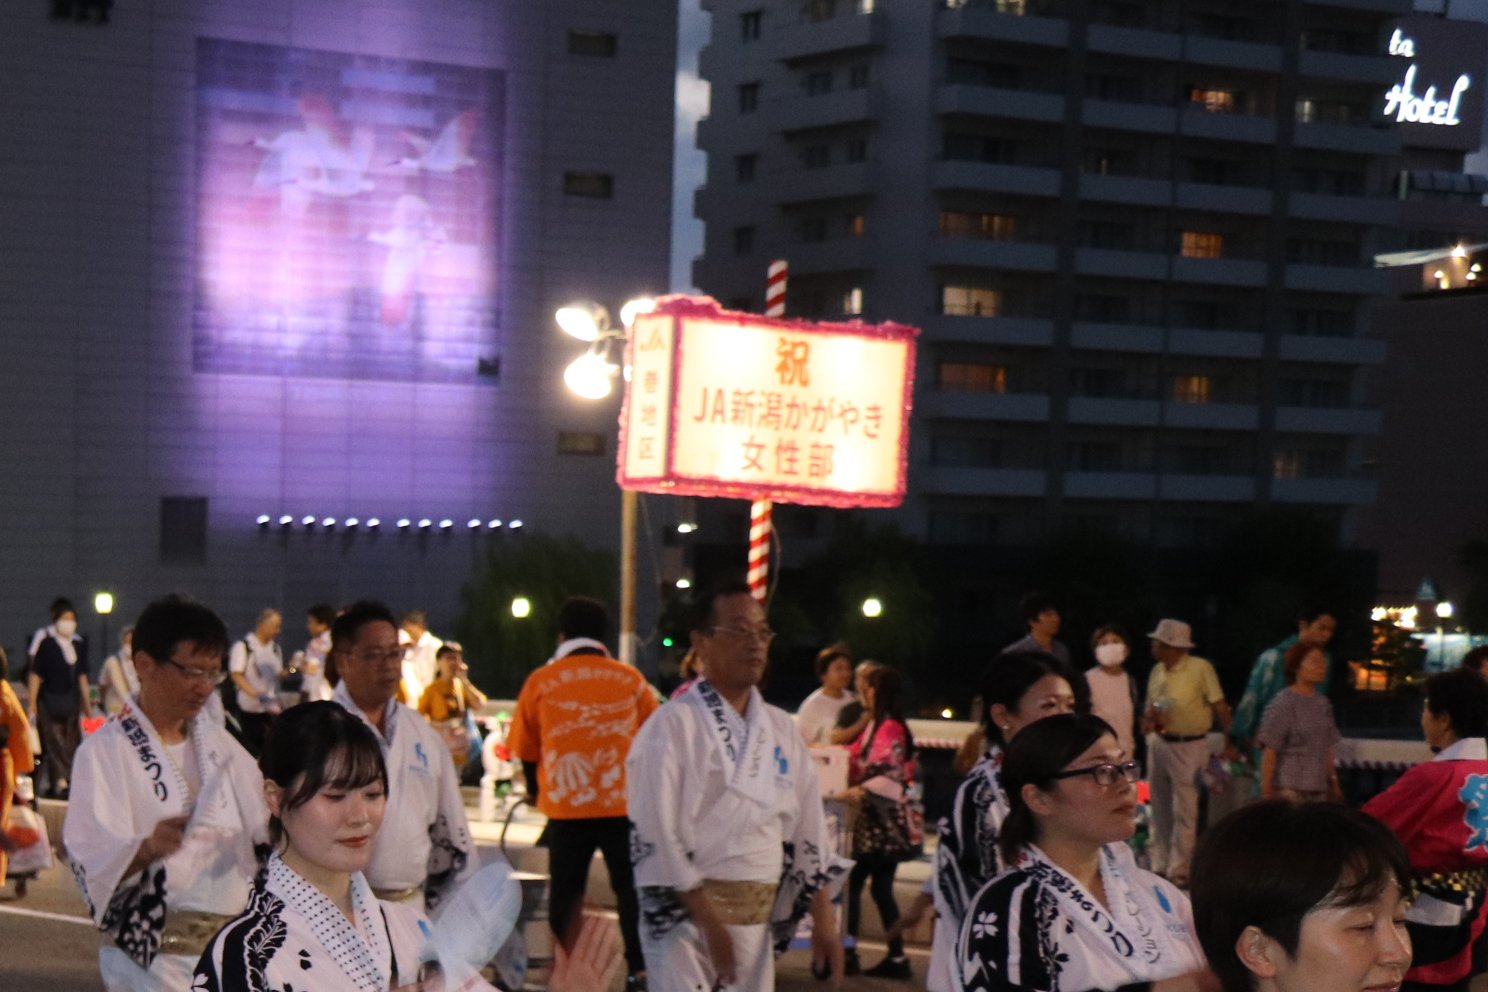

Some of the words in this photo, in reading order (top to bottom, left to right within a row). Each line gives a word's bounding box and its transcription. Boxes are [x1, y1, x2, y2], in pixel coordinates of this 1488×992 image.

[1383, 63, 1470, 126] Hotel
[775, 337, 810, 388] 祝
[693, 386, 884, 440] JA新潟かがやき
[740, 435, 835, 479] 女性部
